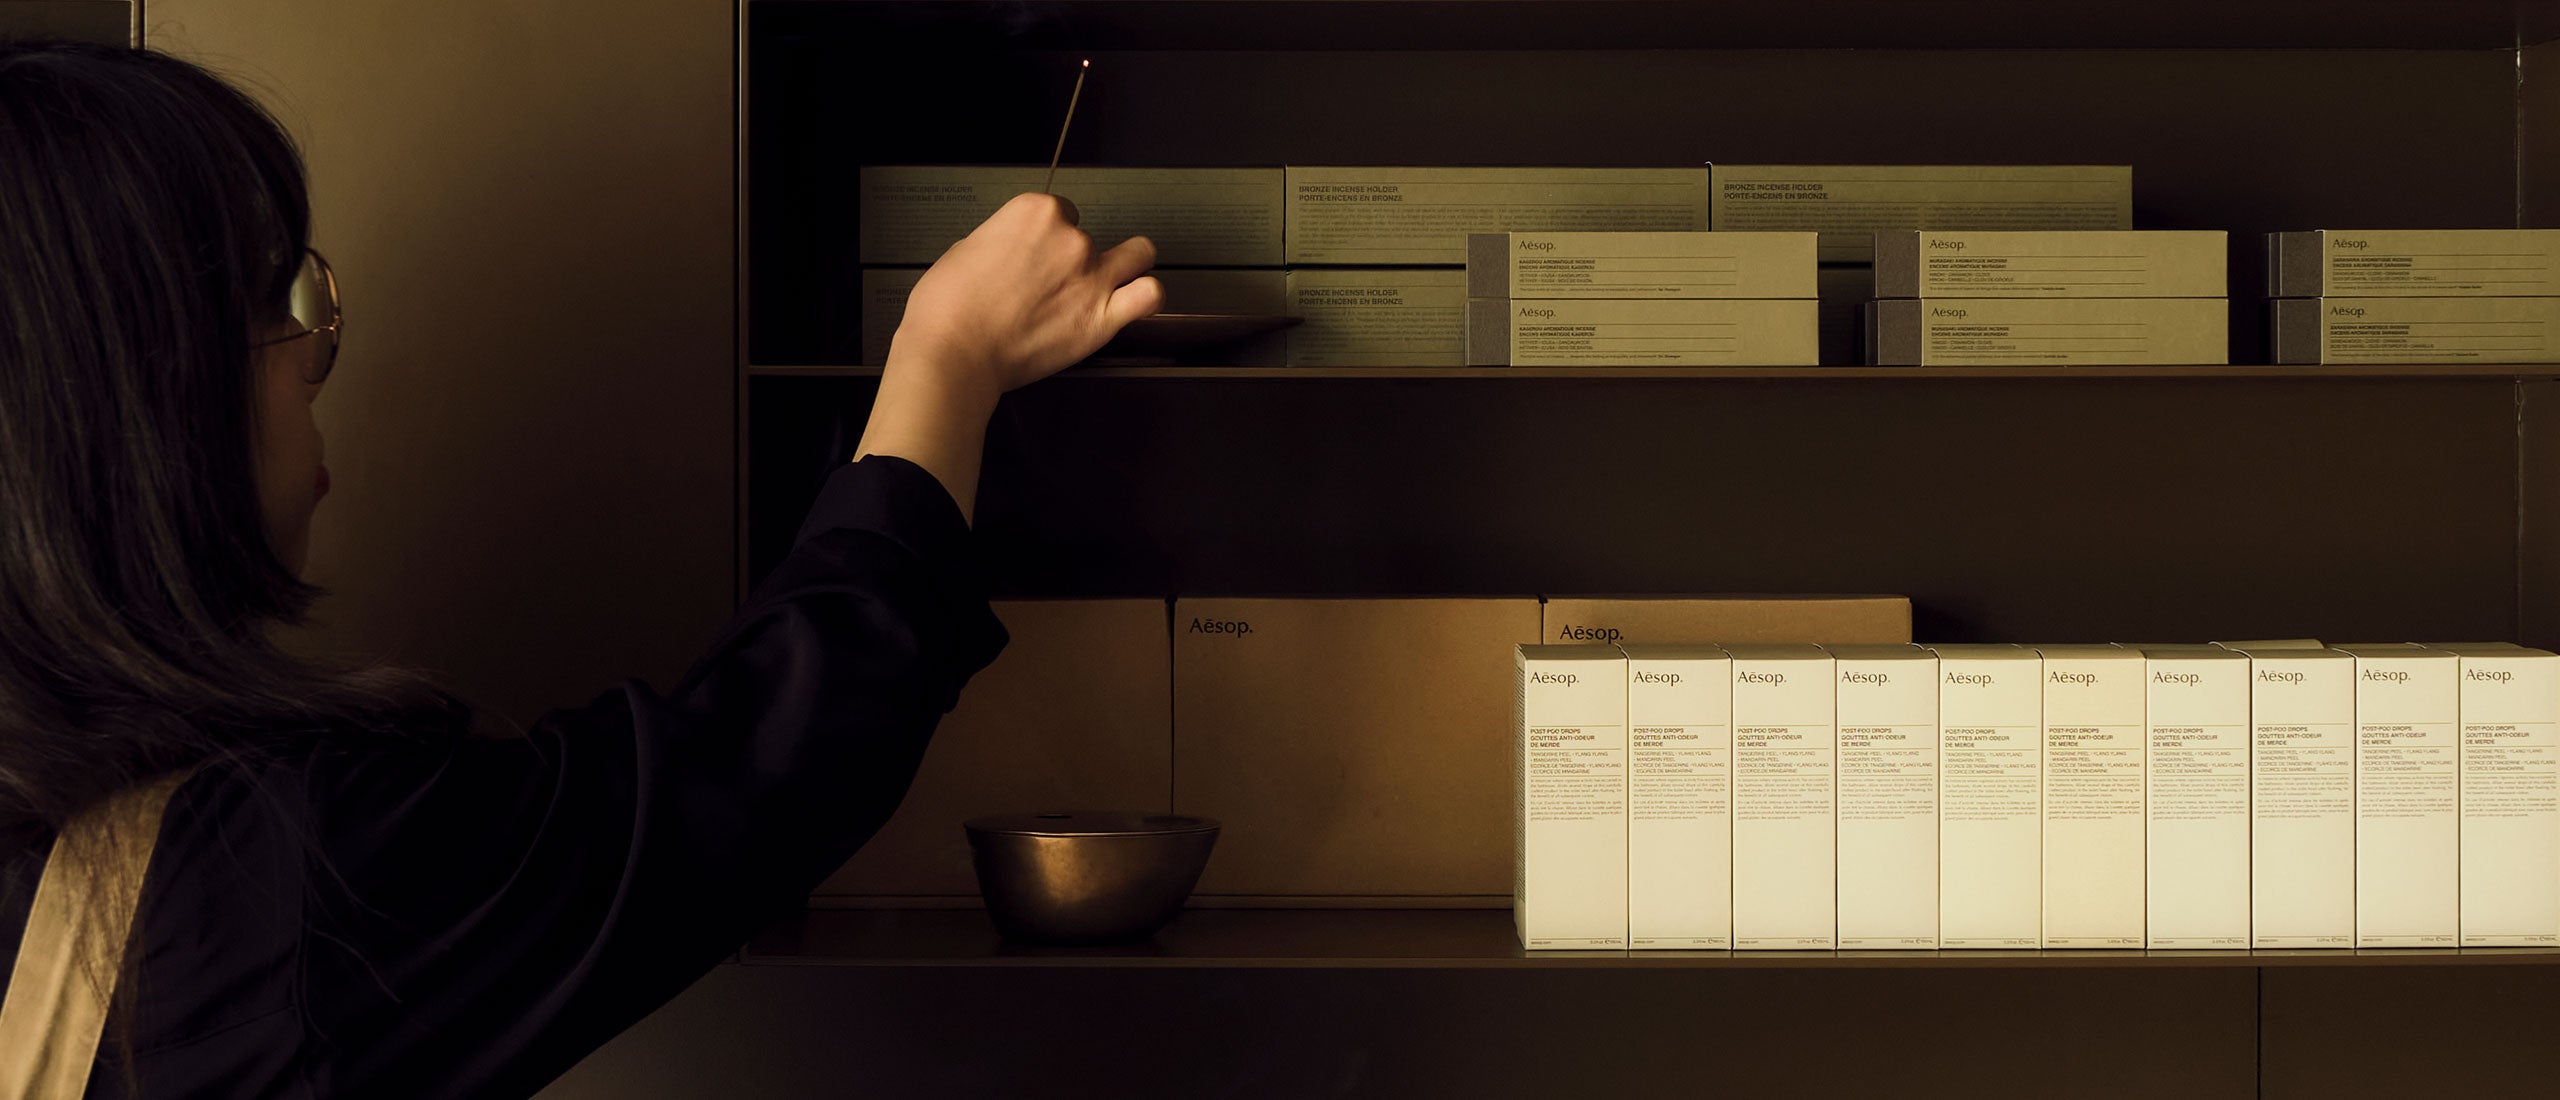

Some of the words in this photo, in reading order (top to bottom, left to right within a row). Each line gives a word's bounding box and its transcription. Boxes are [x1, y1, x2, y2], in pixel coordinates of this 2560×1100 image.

[1189, 618, 1253, 636] Aēsop.
[1560, 624, 1624, 644] Aēsop.
[1530, 672, 1579, 687] Aēsop.
[1634, 671, 1682, 686] Aēsop.
[1738, 671, 1786, 686] Aēsop.
[1842, 671, 1890, 686] Aēsop.
[1945, 672, 1994, 687] Aēsop.
[2049, 671, 2098, 686] Aēsop.
[2153, 671, 2202, 686] Aēsop.
[2258, 670, 2306, 685] Aēsop.
[2362, 669, 2411, 684] Aēsop.
[2465, 669, 2514, 684] Aēsop.
